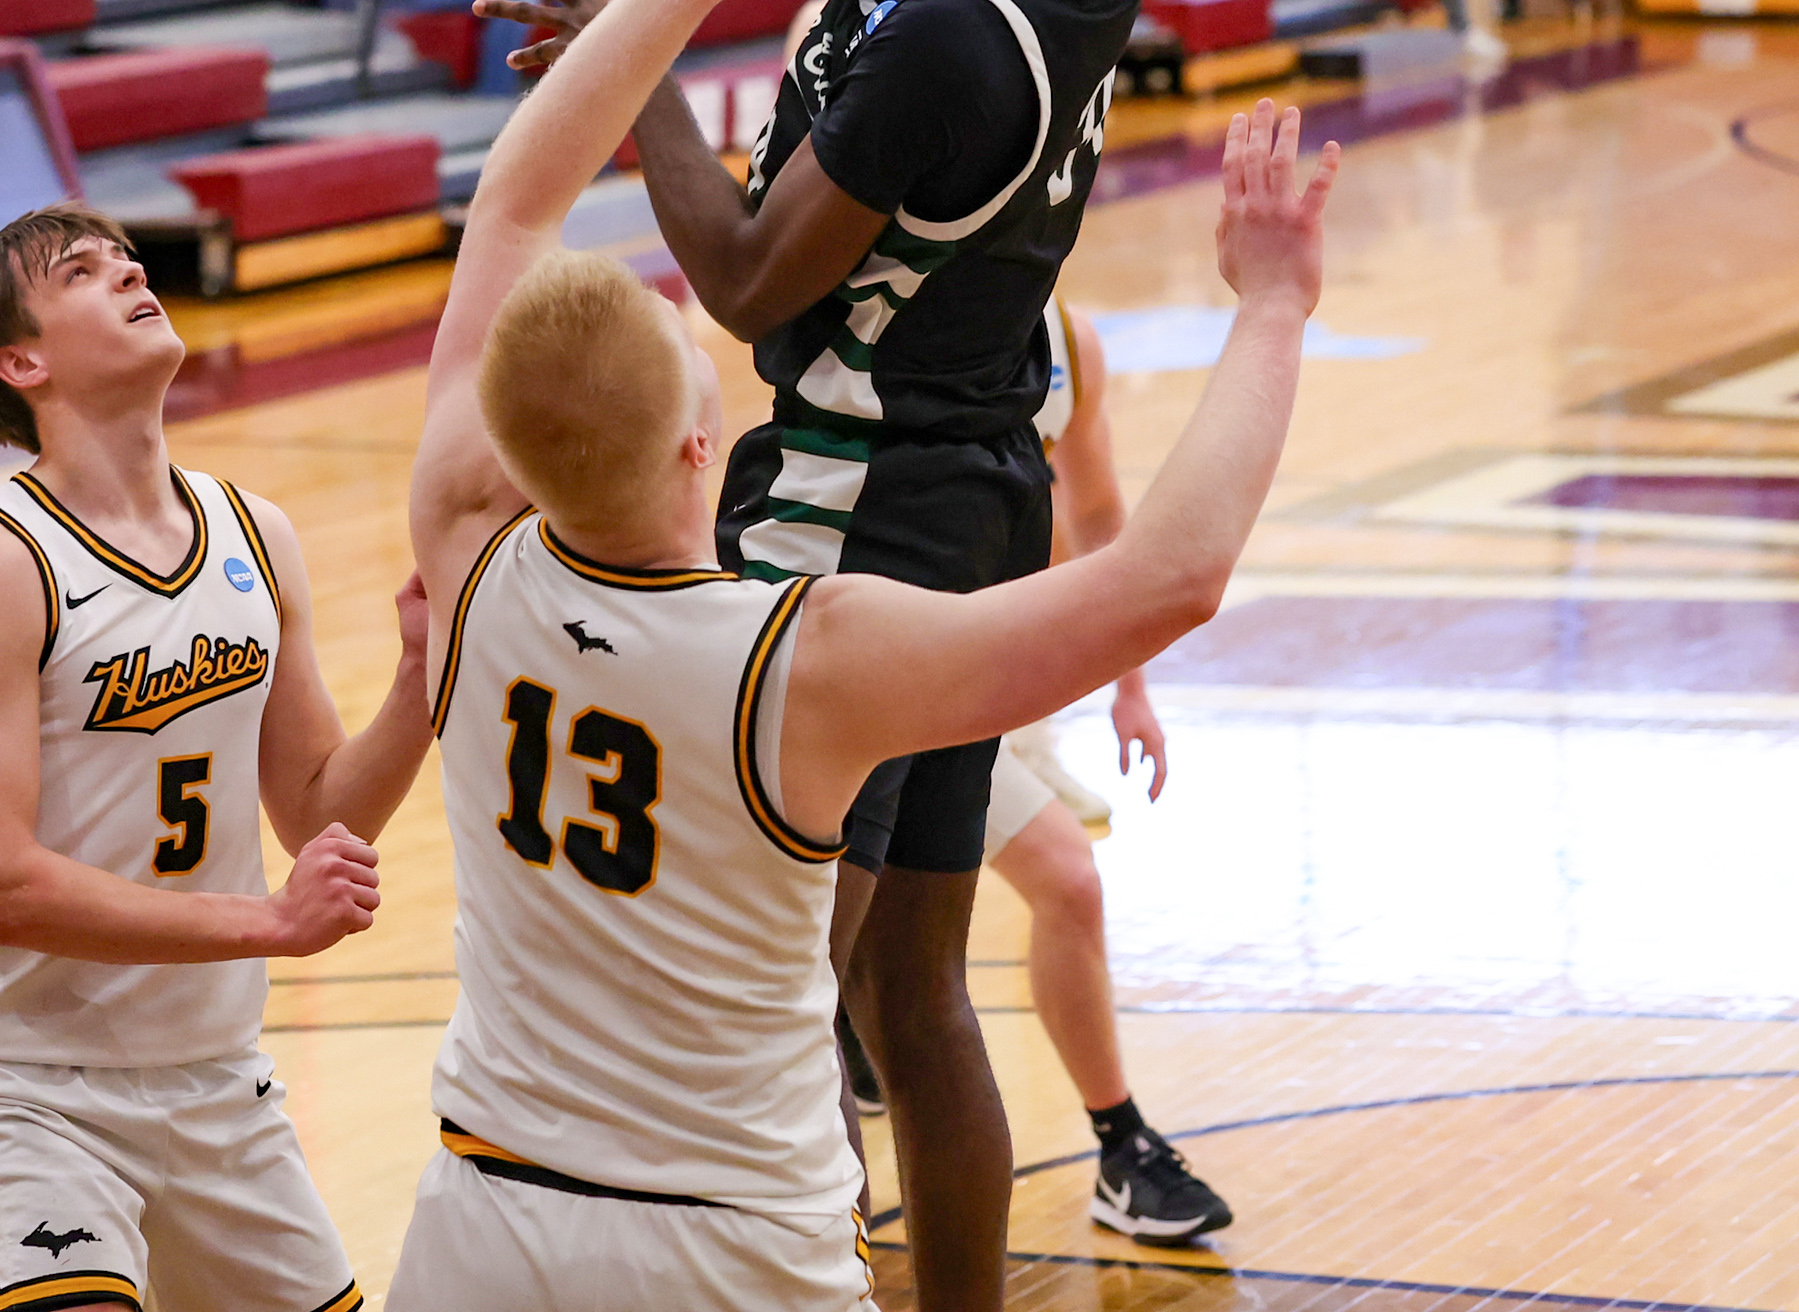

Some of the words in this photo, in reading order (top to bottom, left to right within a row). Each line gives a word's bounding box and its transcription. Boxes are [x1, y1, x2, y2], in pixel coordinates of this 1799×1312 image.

[82, 634, 268, 730] Huskies
[151, 751, 213, 878] 5
[496, 674, 663, 899] 13
